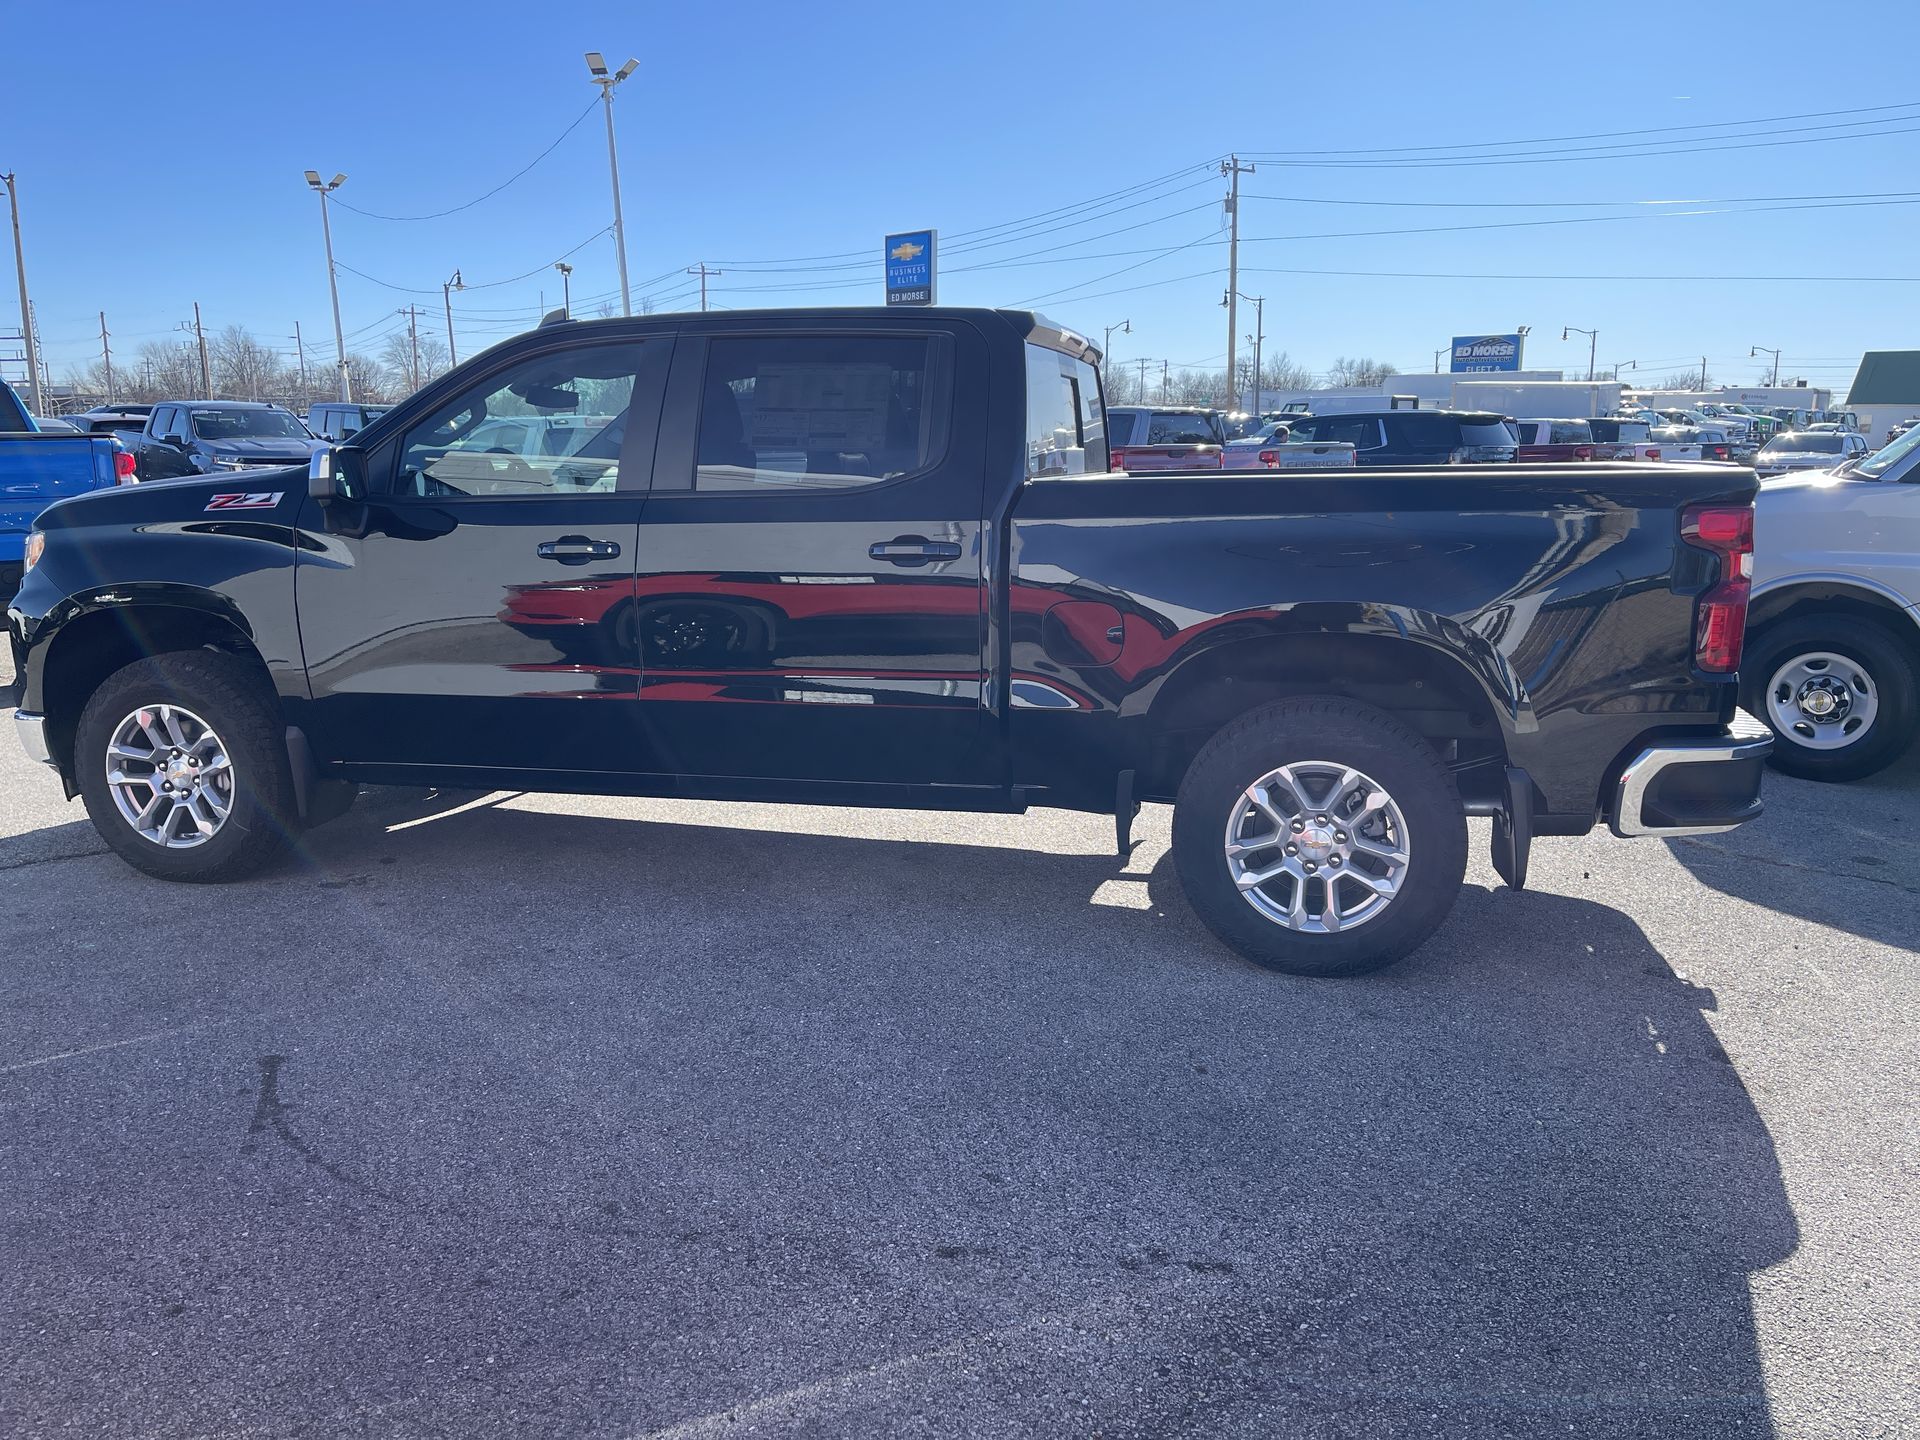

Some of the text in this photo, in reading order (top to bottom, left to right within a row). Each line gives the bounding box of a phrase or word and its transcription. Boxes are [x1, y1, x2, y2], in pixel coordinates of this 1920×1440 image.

[890, 266, 926, 276] BUSINESS
[897, 275, 918, 284] ELITE
[891, 291, 925, 302] ED MORSE
[1455, 345, 1515, 357] ED MORSE
[203, 491, 286, 512] Z71
